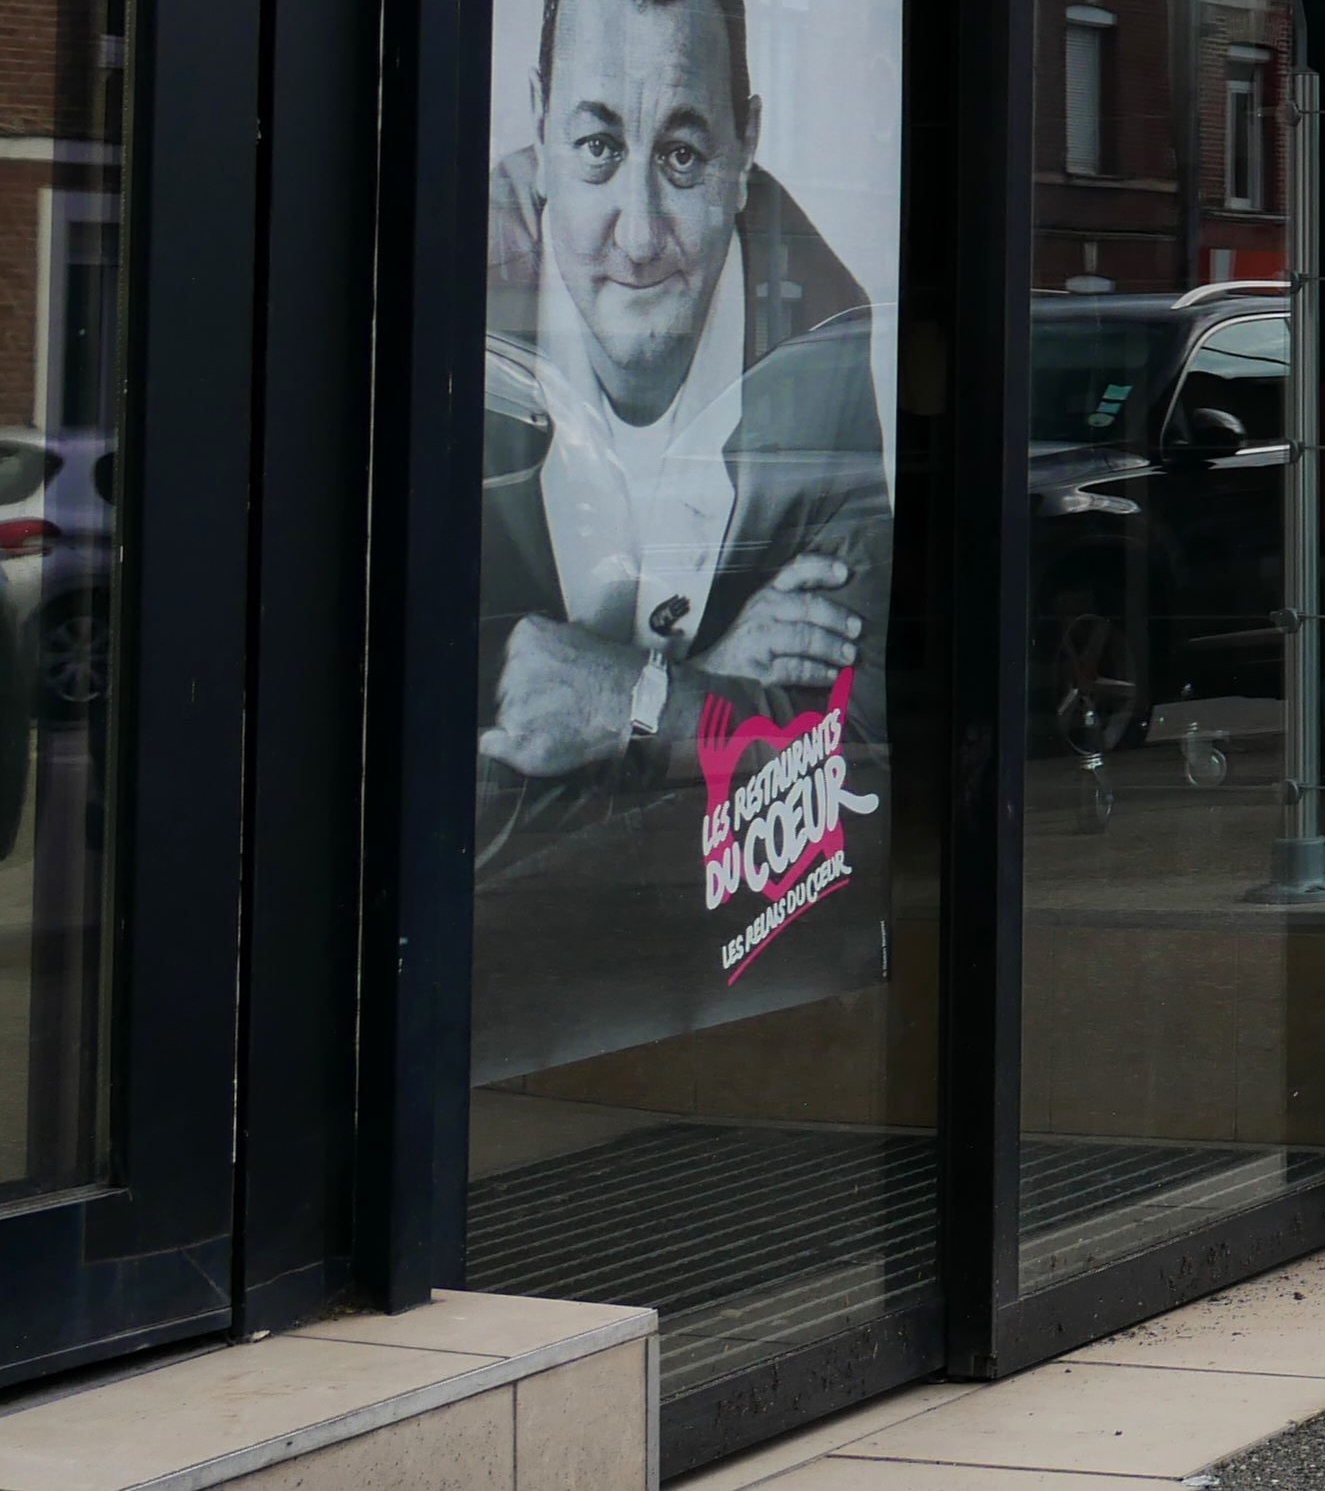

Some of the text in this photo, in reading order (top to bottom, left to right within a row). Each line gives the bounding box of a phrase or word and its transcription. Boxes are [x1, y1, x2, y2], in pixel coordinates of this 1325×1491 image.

[702, 708, 842, 856] LES RESTAURANTS
[705, 841, 741, 910] DU
[722, 934, 744, 969] LES
[745, 897, 786, 953] RELAIS
[786, 882, 806, 914] DU
